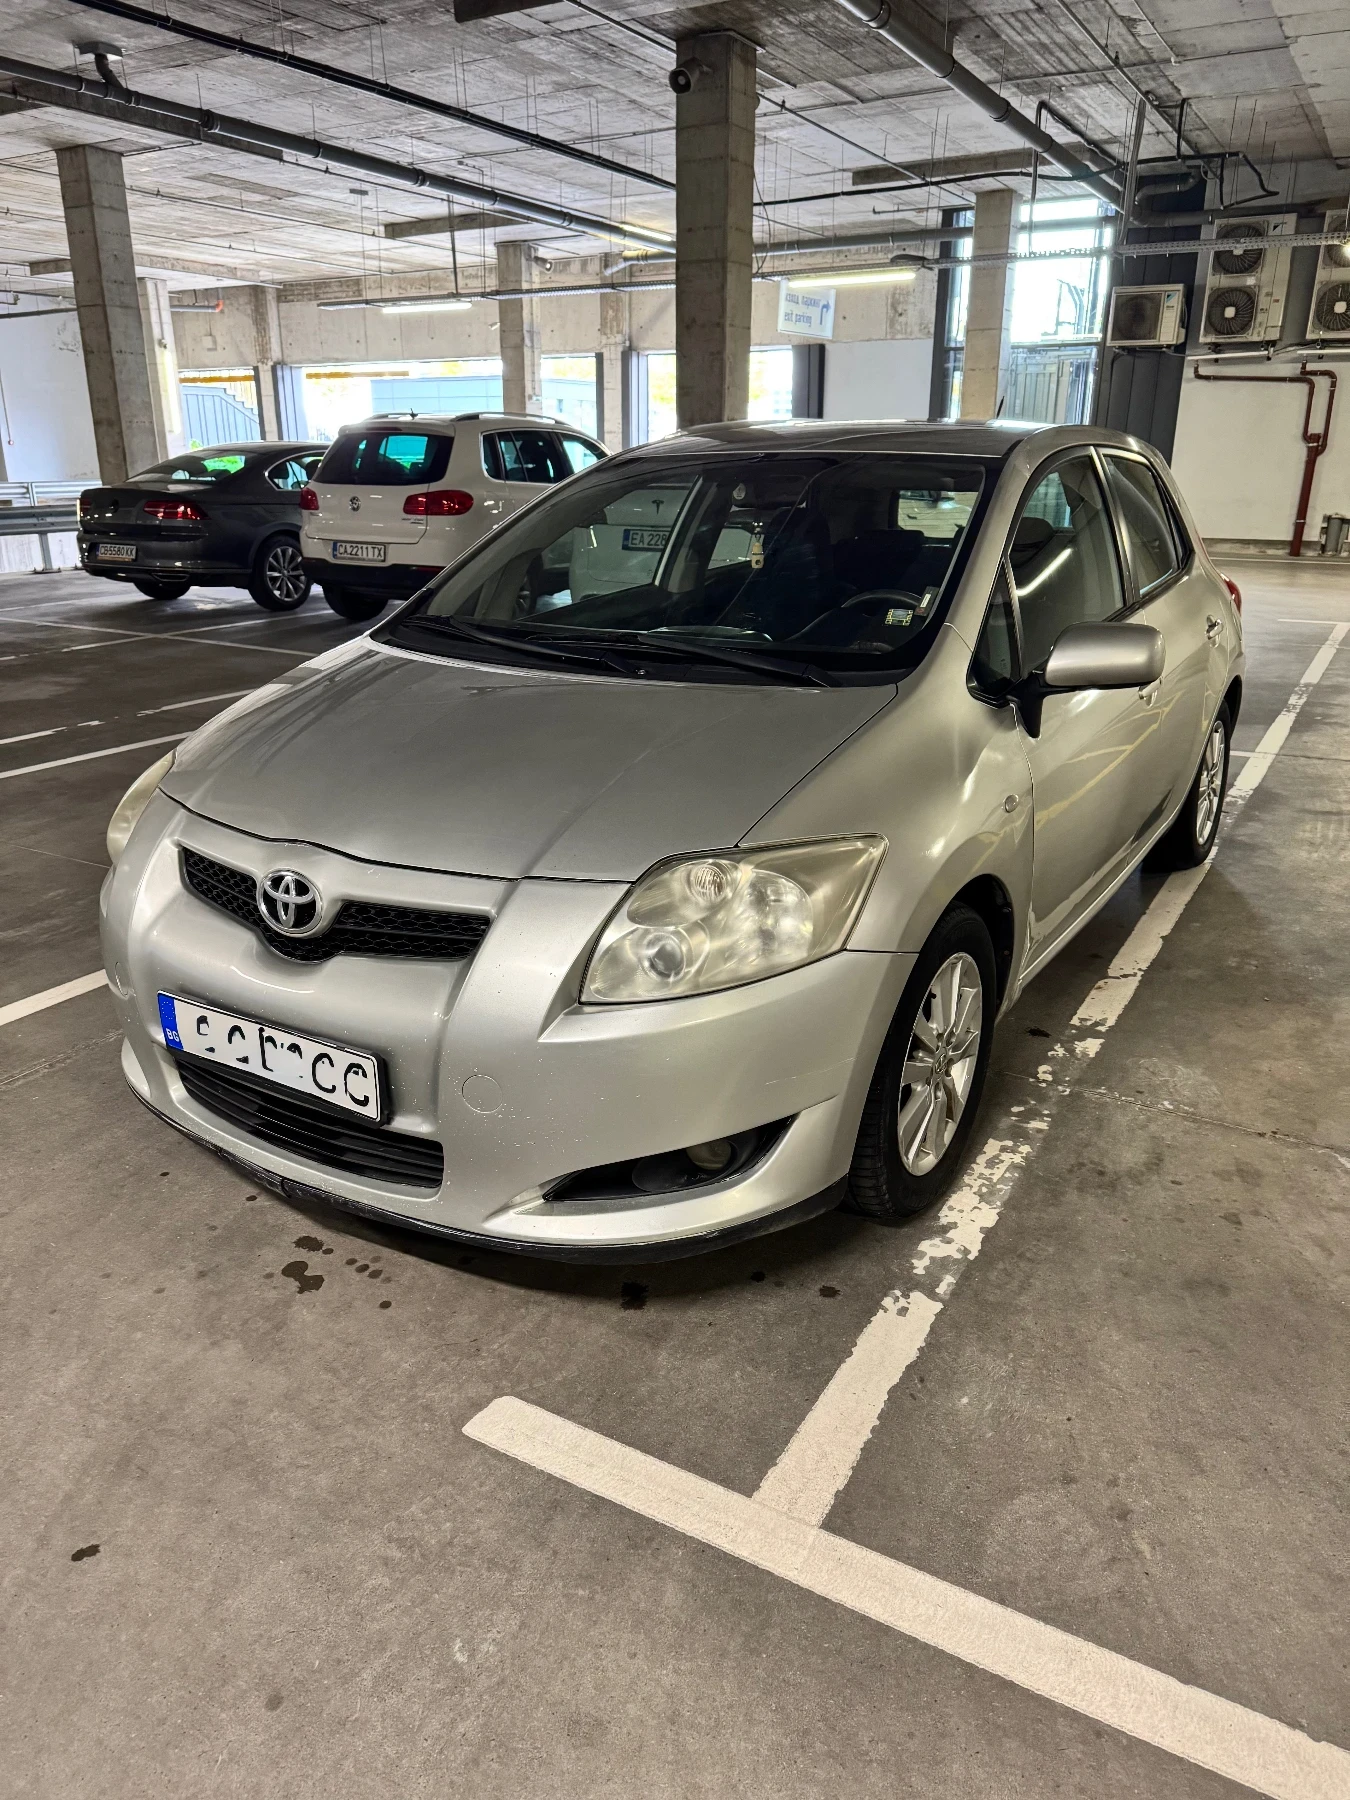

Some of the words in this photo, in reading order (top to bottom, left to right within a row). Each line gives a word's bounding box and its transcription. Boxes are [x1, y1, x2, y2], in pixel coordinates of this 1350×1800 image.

[795, 312, 812, 327] parking
[630, 532, 645, 546] EA
[166, 1027, 180, 1043] BG
